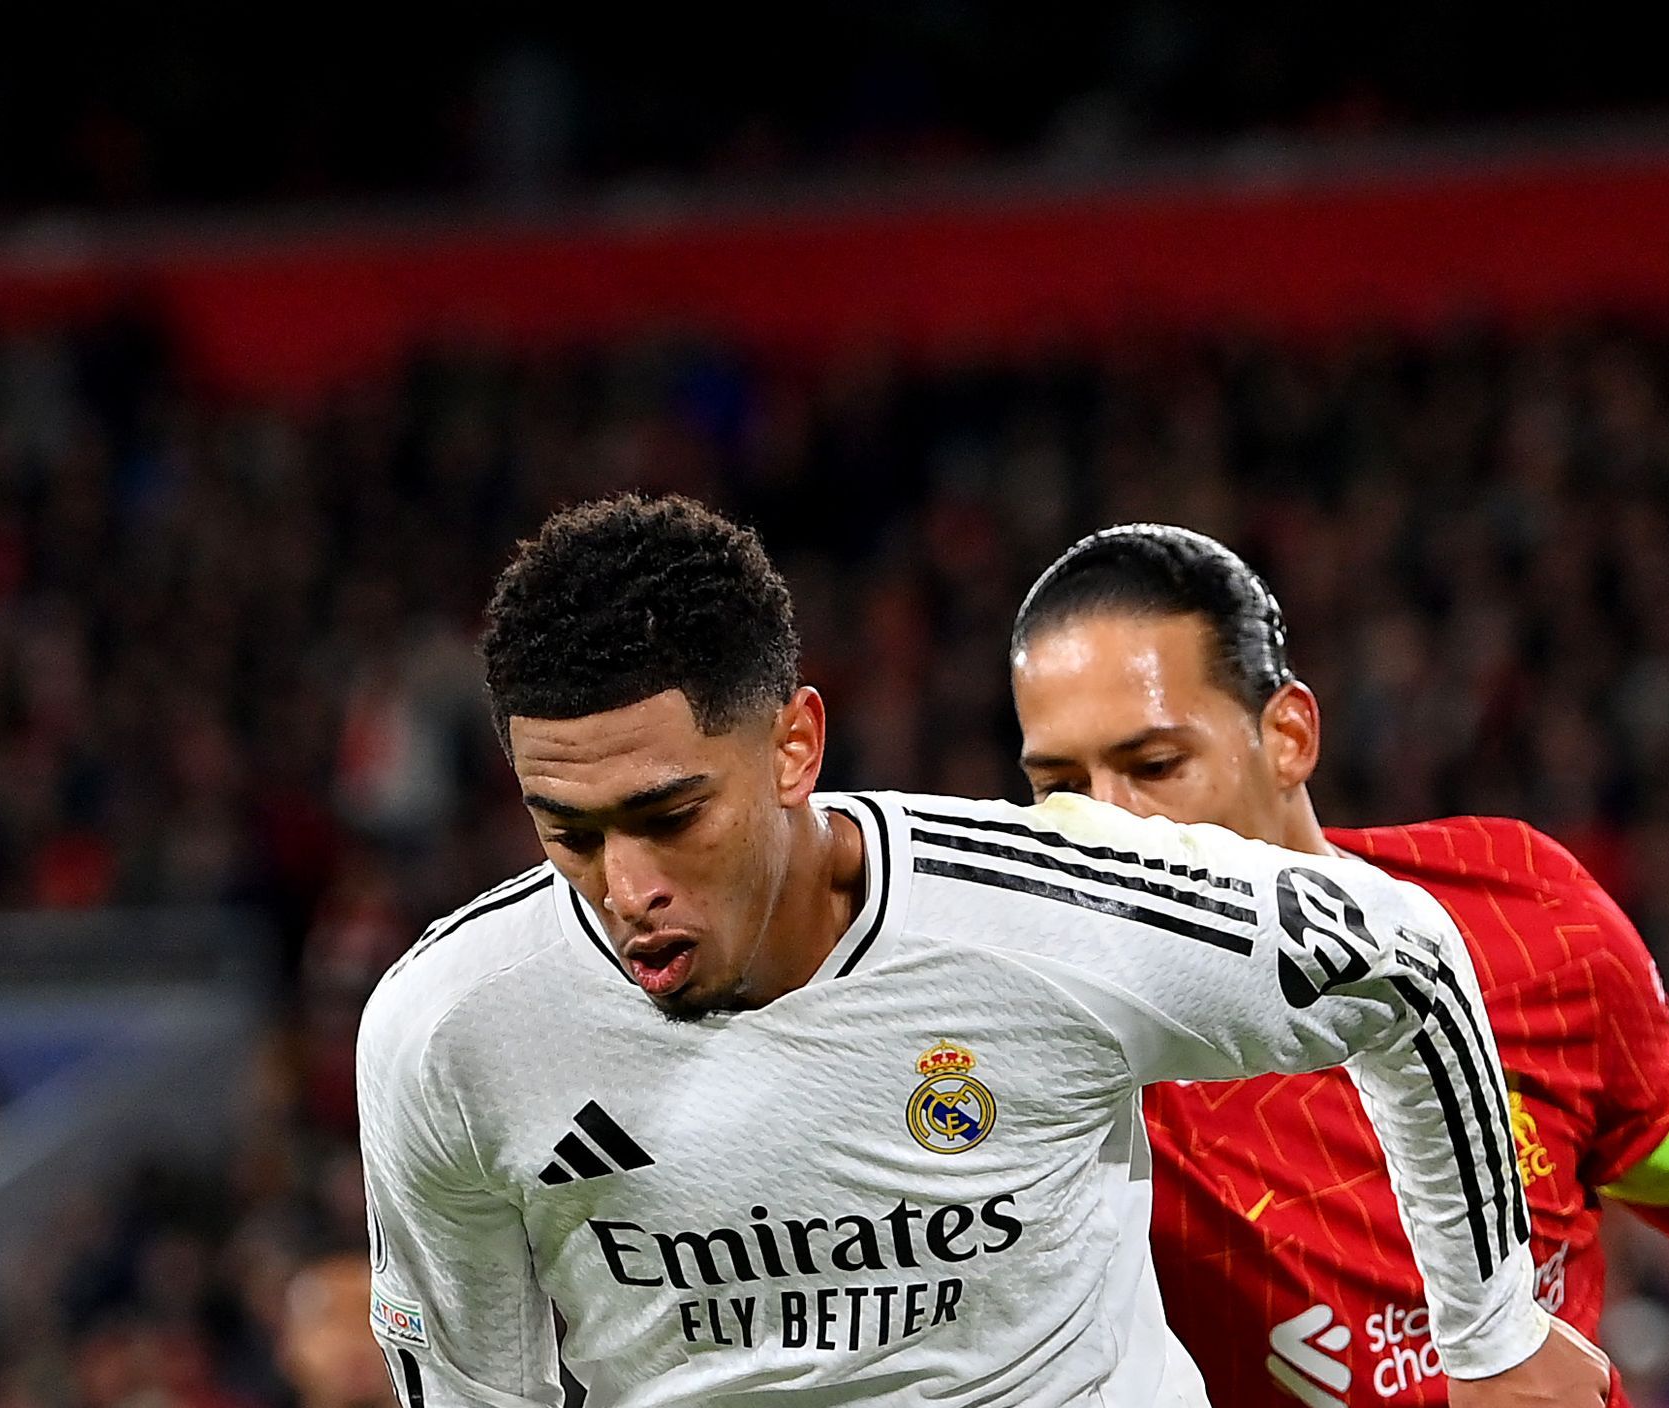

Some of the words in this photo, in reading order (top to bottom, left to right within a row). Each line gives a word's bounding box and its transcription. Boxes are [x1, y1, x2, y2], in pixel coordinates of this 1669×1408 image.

[586, 1193, 1023, 1290] Emirates
[679, 1299, 756, 1349] FLY
[782, 1278, 963, 1352] BETTER
